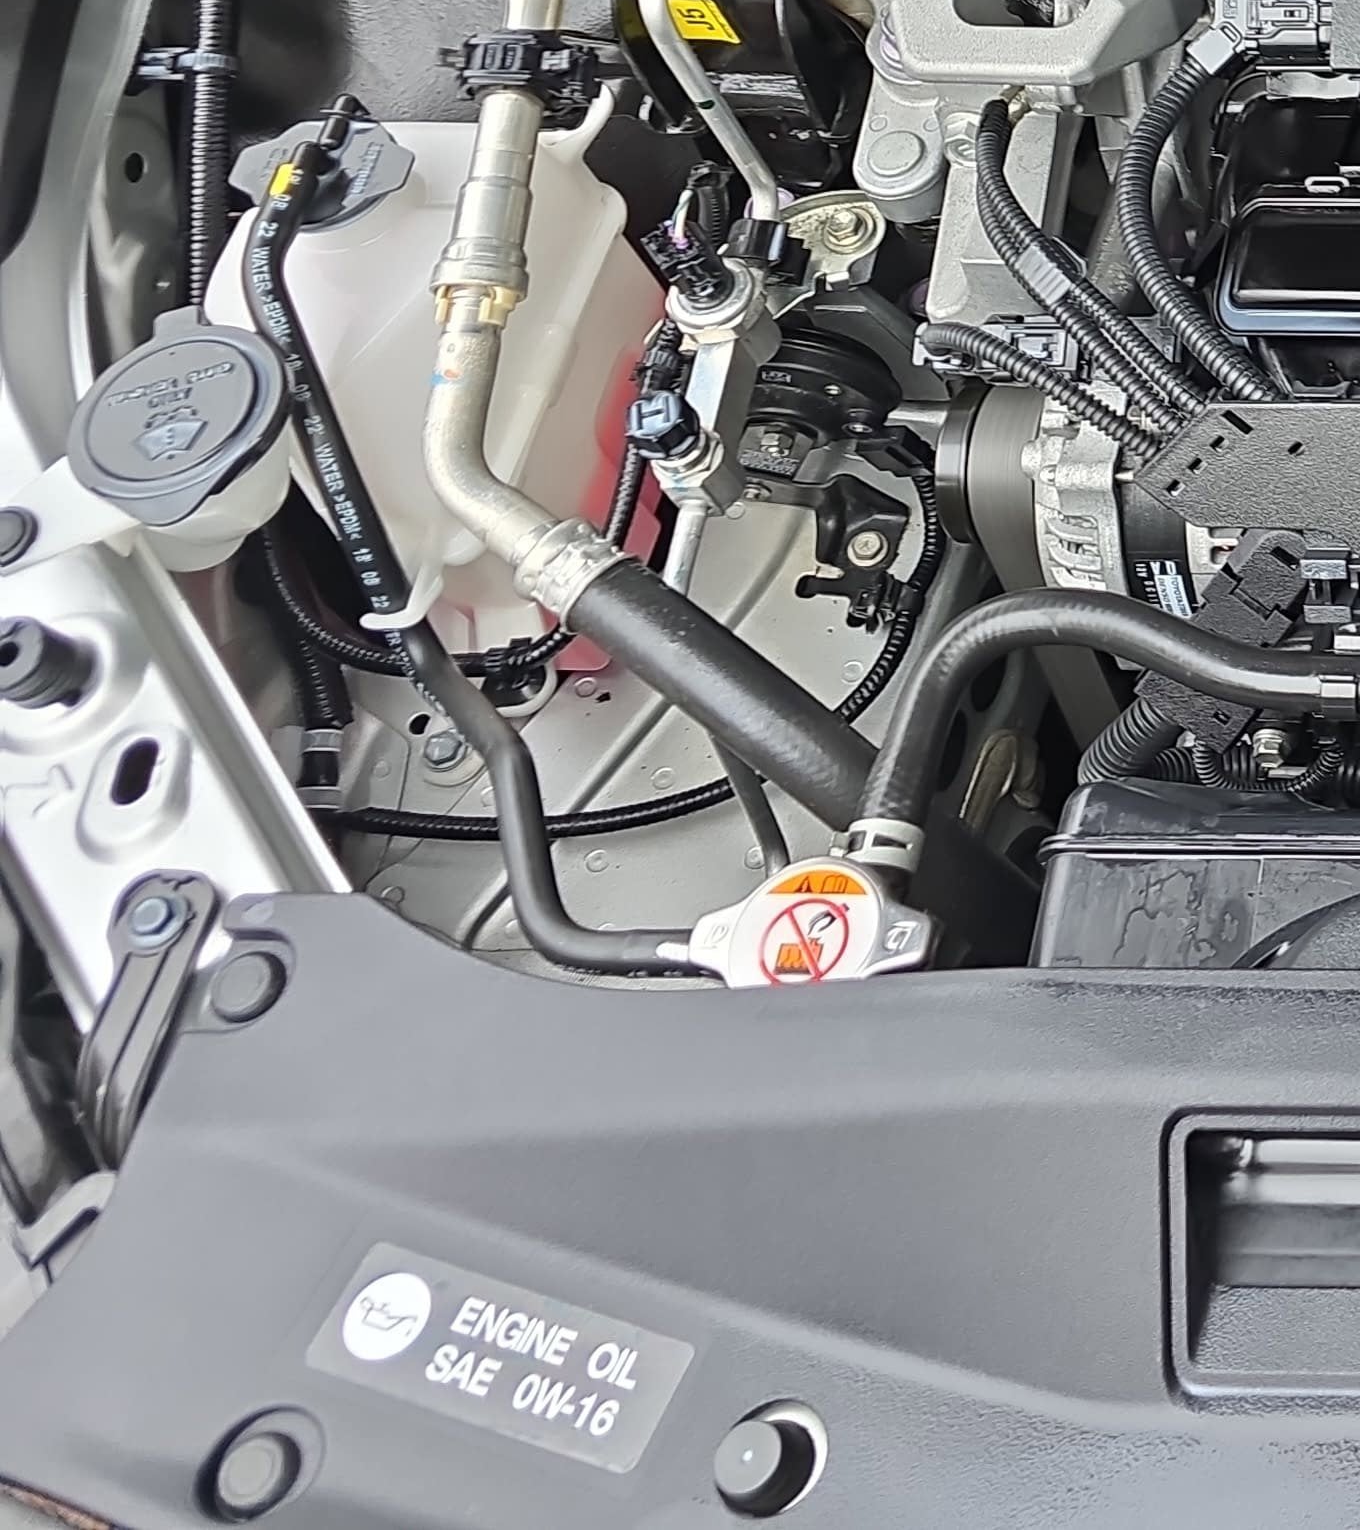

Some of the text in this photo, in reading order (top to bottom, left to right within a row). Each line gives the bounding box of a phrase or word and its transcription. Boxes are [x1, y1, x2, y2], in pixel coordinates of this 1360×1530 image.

[676, 0, 716, 35] J5
[249, 244, 275, 291] WATER
[313, 442, 345, 494] WATER
[424, 1343, 621, 1437] SAE 0W-16
[450, 1296, 640, 1391] ENGINE OIL
